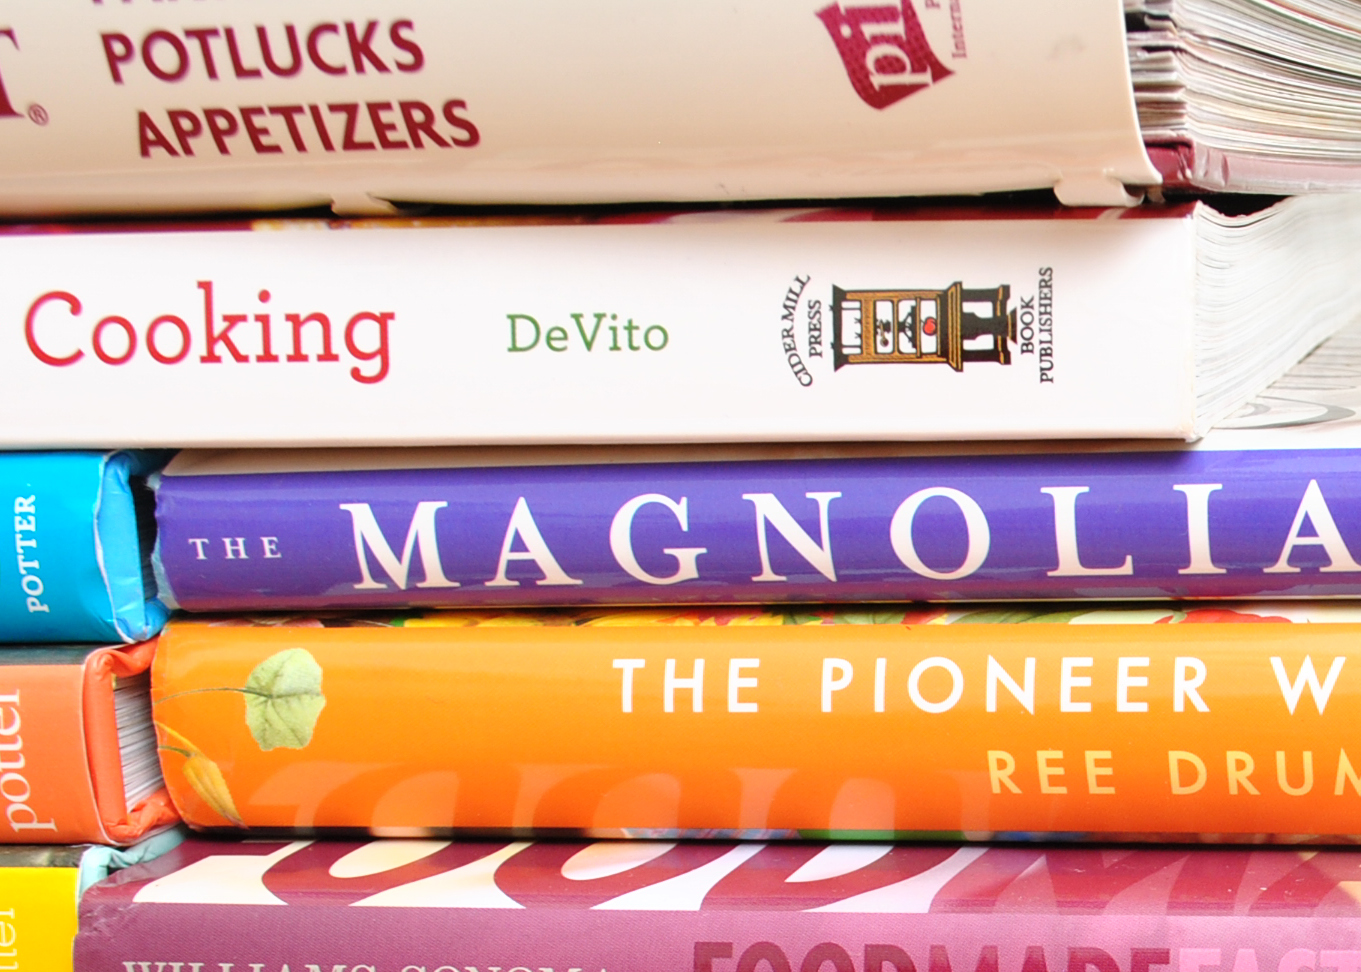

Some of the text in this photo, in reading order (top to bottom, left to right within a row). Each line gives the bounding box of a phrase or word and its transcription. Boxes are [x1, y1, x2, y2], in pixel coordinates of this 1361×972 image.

[100, 19, 426, 85] POTLUCKS
[136, 97, 482, 158] APPETIZERS
[24, 280, 396, 385] Cooking
[505, 311, 670, 353] DeVito
[780, 273, 814, 388] CIDER MILL
[807, 298, 823, 359] PRESS
[1020, 295, 1035, 356] BOOK
[1038, 266, 1055, 385] PUBLISHERS
[14, 494, 50, 614] POTTER
[188, 535, 283, 561] THE
[611, 657, 761, 714] THE
[820, 655, 1211, 715] PIONEER
[987, 748, 1117, 796] REE
